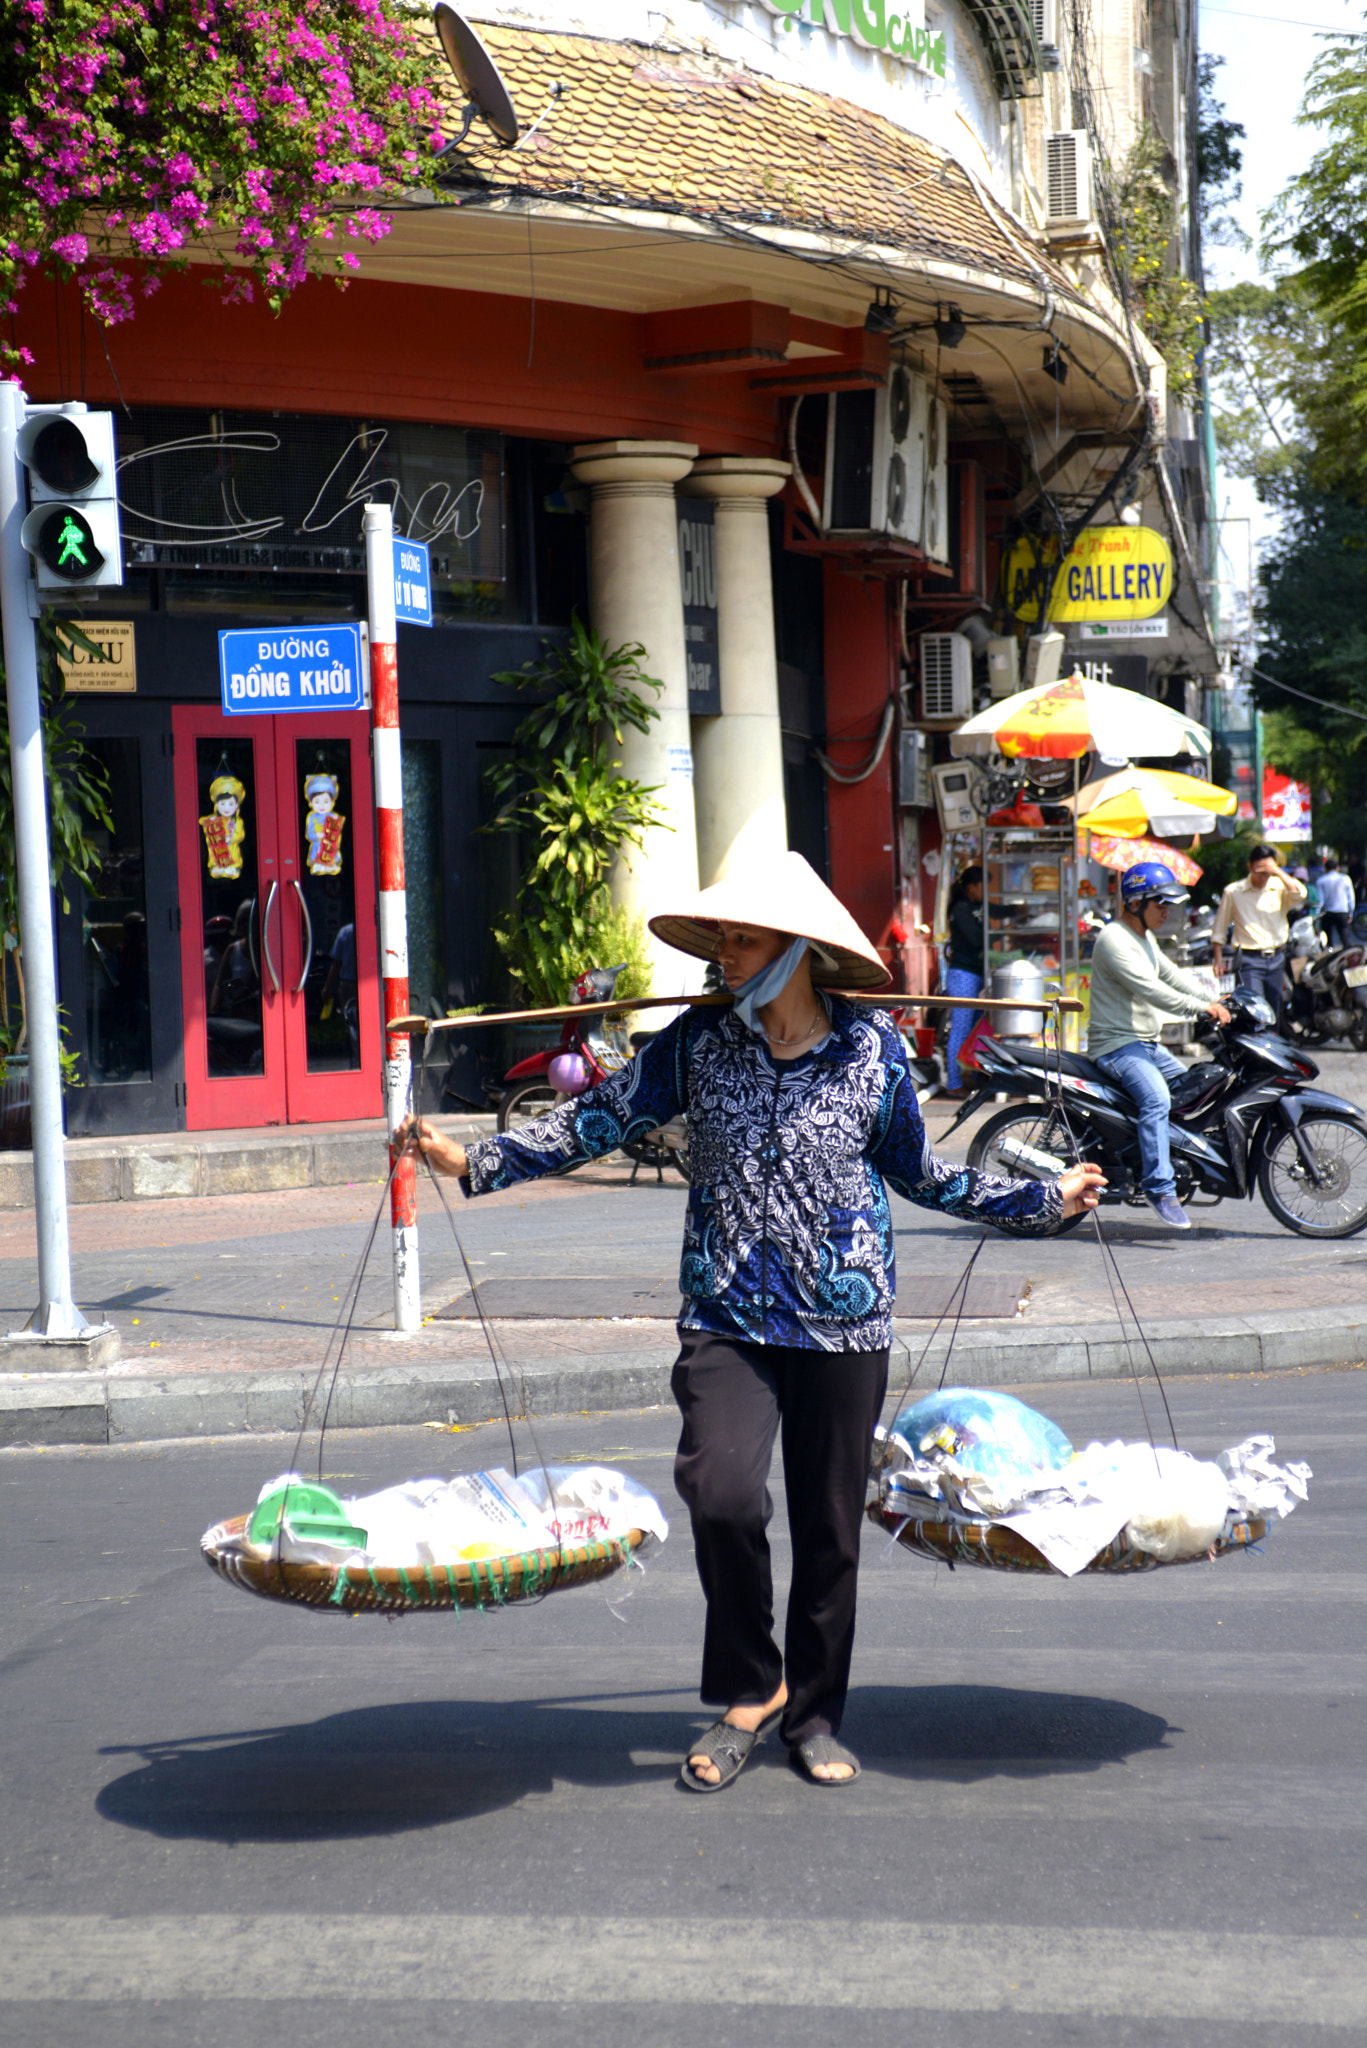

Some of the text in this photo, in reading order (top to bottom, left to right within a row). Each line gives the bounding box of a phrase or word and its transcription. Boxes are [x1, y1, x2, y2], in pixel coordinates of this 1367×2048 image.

[1090, 537, 1130, 553] Tranh
[1067, 563, 1165, 602] GALLERY
[258, 637, 329, 660] ĐƯỜNG
[230, 660, 351, 699] ĐỒNG KHỞI
[687, 653, 713, 692] bar
